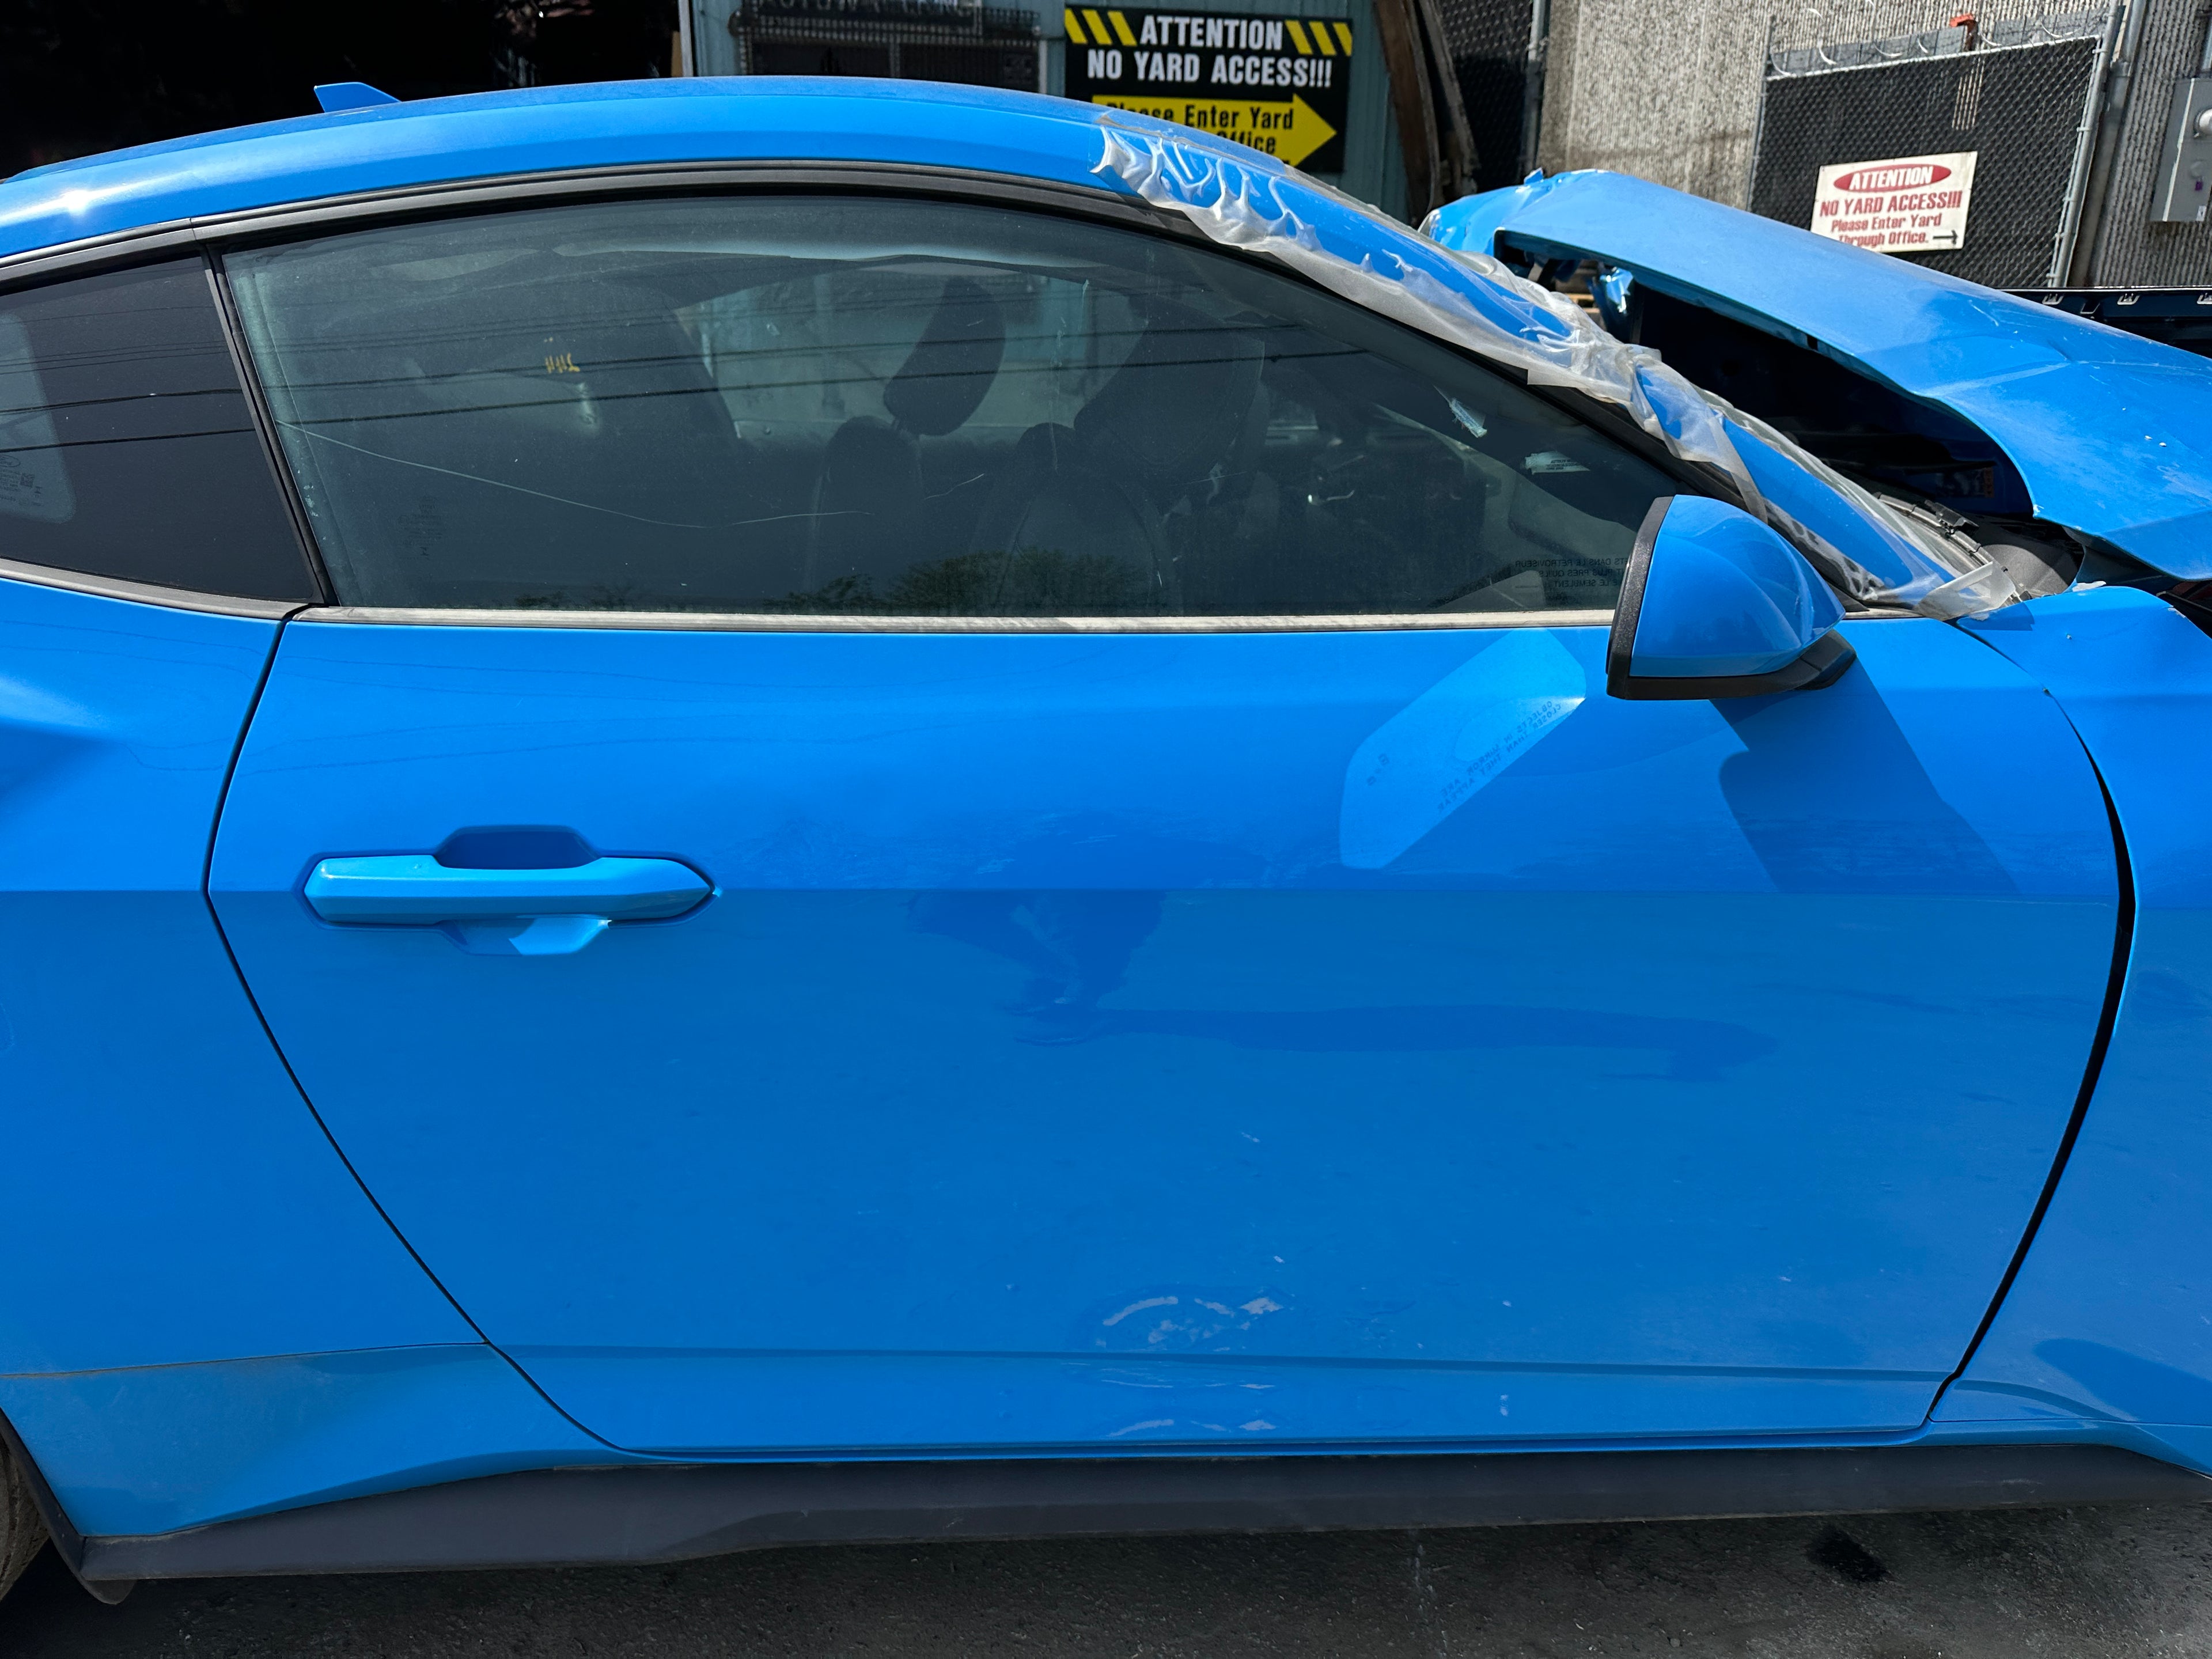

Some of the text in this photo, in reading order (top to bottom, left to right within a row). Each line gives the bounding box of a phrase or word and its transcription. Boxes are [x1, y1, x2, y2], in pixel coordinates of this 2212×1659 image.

[1140, 15, 1282, 50] ATTENTION
[1088, 50, 1332, 88] NO YARD ACCESS!!!
[1185, 105, 1240, 128] Enter
[1250, 108, 1294, 130] Yard
[1849, 166, 1933, 190] ATTENTION
[1820, 191, 1962, 217] NO YARD ACCESS!!!
[1831, 213, 1942, 233] Please Enter Yard
[1888, 232, 1929, 245] Office.
